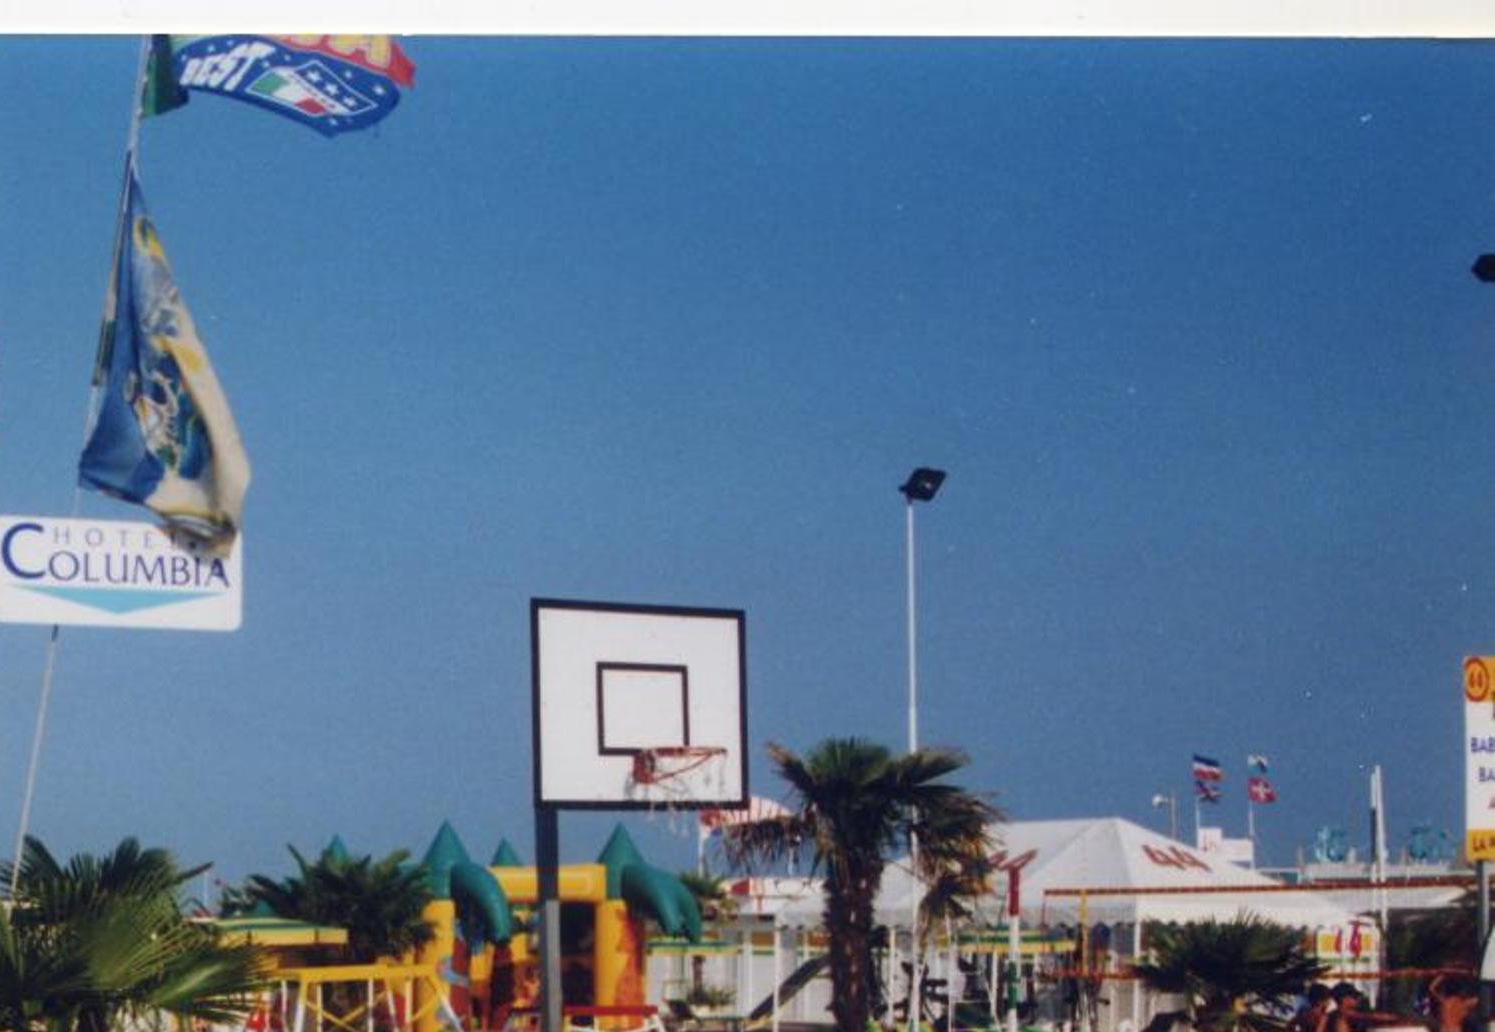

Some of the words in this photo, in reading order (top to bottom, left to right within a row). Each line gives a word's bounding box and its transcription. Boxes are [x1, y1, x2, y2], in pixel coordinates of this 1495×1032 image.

[55, 526, 179, 549] HOTE
[1, 522, 230, 588] COLUMBIA
[1142, 844, 1213, 873] 44
